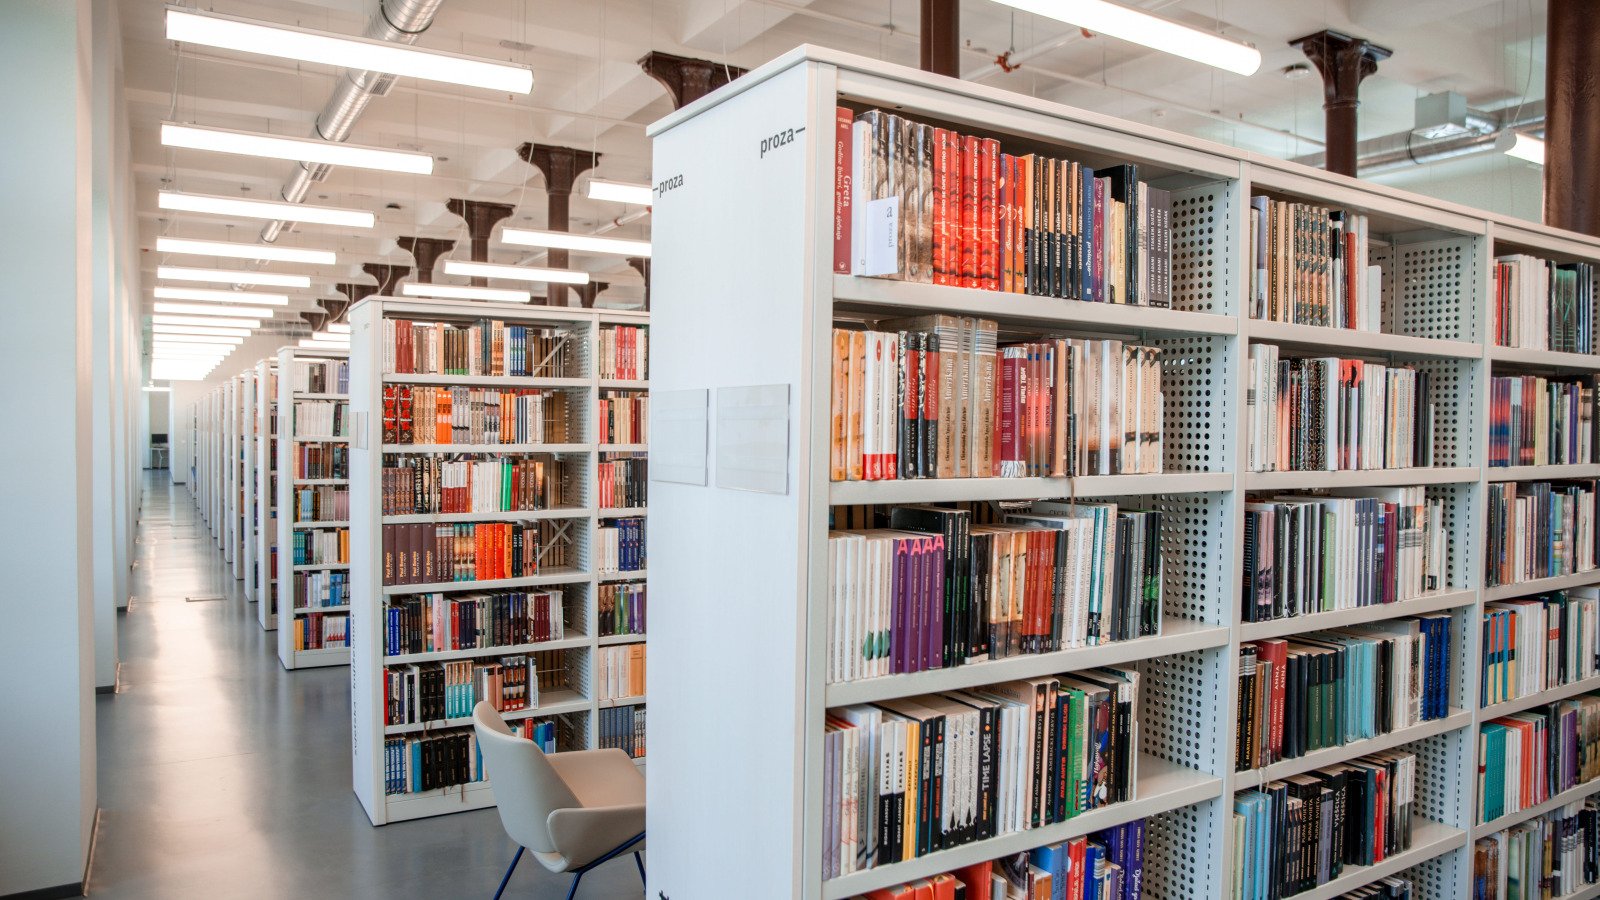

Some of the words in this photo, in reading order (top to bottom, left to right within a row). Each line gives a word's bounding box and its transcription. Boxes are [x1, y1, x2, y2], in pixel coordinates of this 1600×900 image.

[843, 175, 851, 207] Greta
[944, 358, 954, 402] Amerikana
[960, 359, 969, 401] Amerikana
[984, 361, 992, 403] Amerikana
[896, 539, 908, 556] A
[910, 539, 922, 556] A
[921, 538, 934, 554] A
[932, 535, 945, 550] A
[982, 733, 991, 763] LAPSE
[982, 764, 990, 791] TIME
